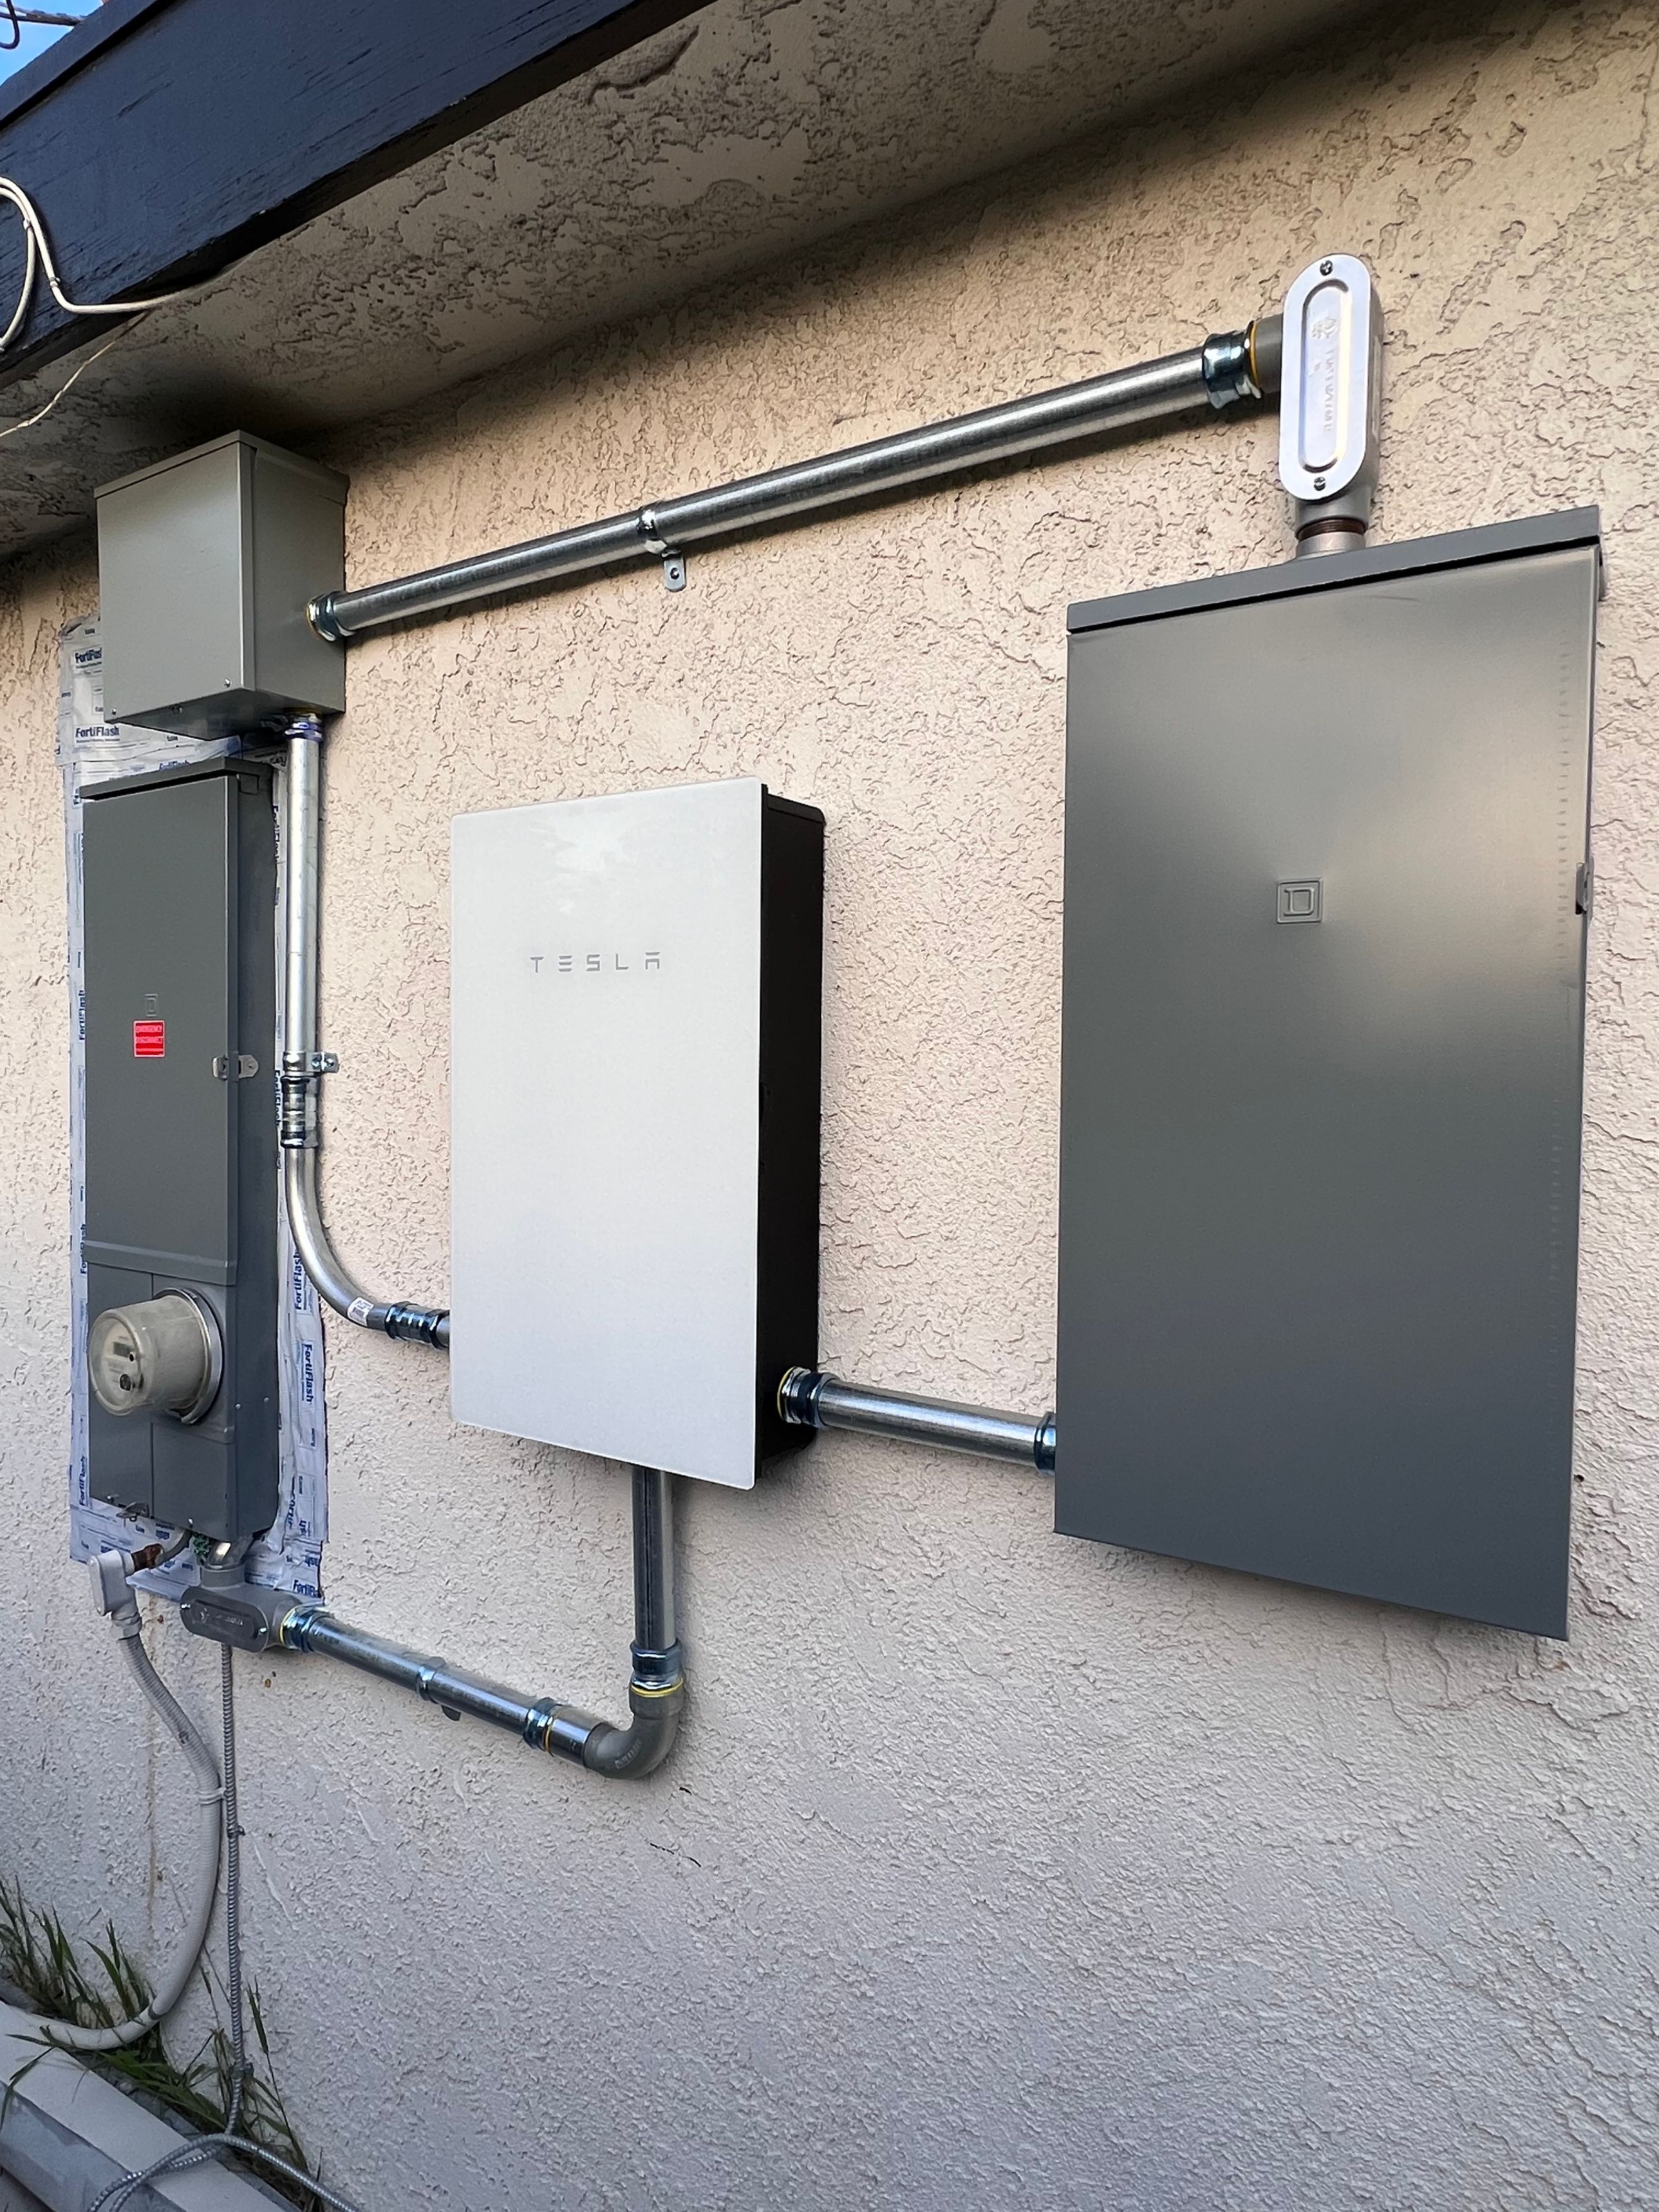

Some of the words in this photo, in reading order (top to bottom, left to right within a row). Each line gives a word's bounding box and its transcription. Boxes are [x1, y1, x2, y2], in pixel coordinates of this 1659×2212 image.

[75, 726, 120, 738] FortiFlash
[529, 951, 661, 973] TESLA
[305, 1344, 313, 1403] FortiFlash
